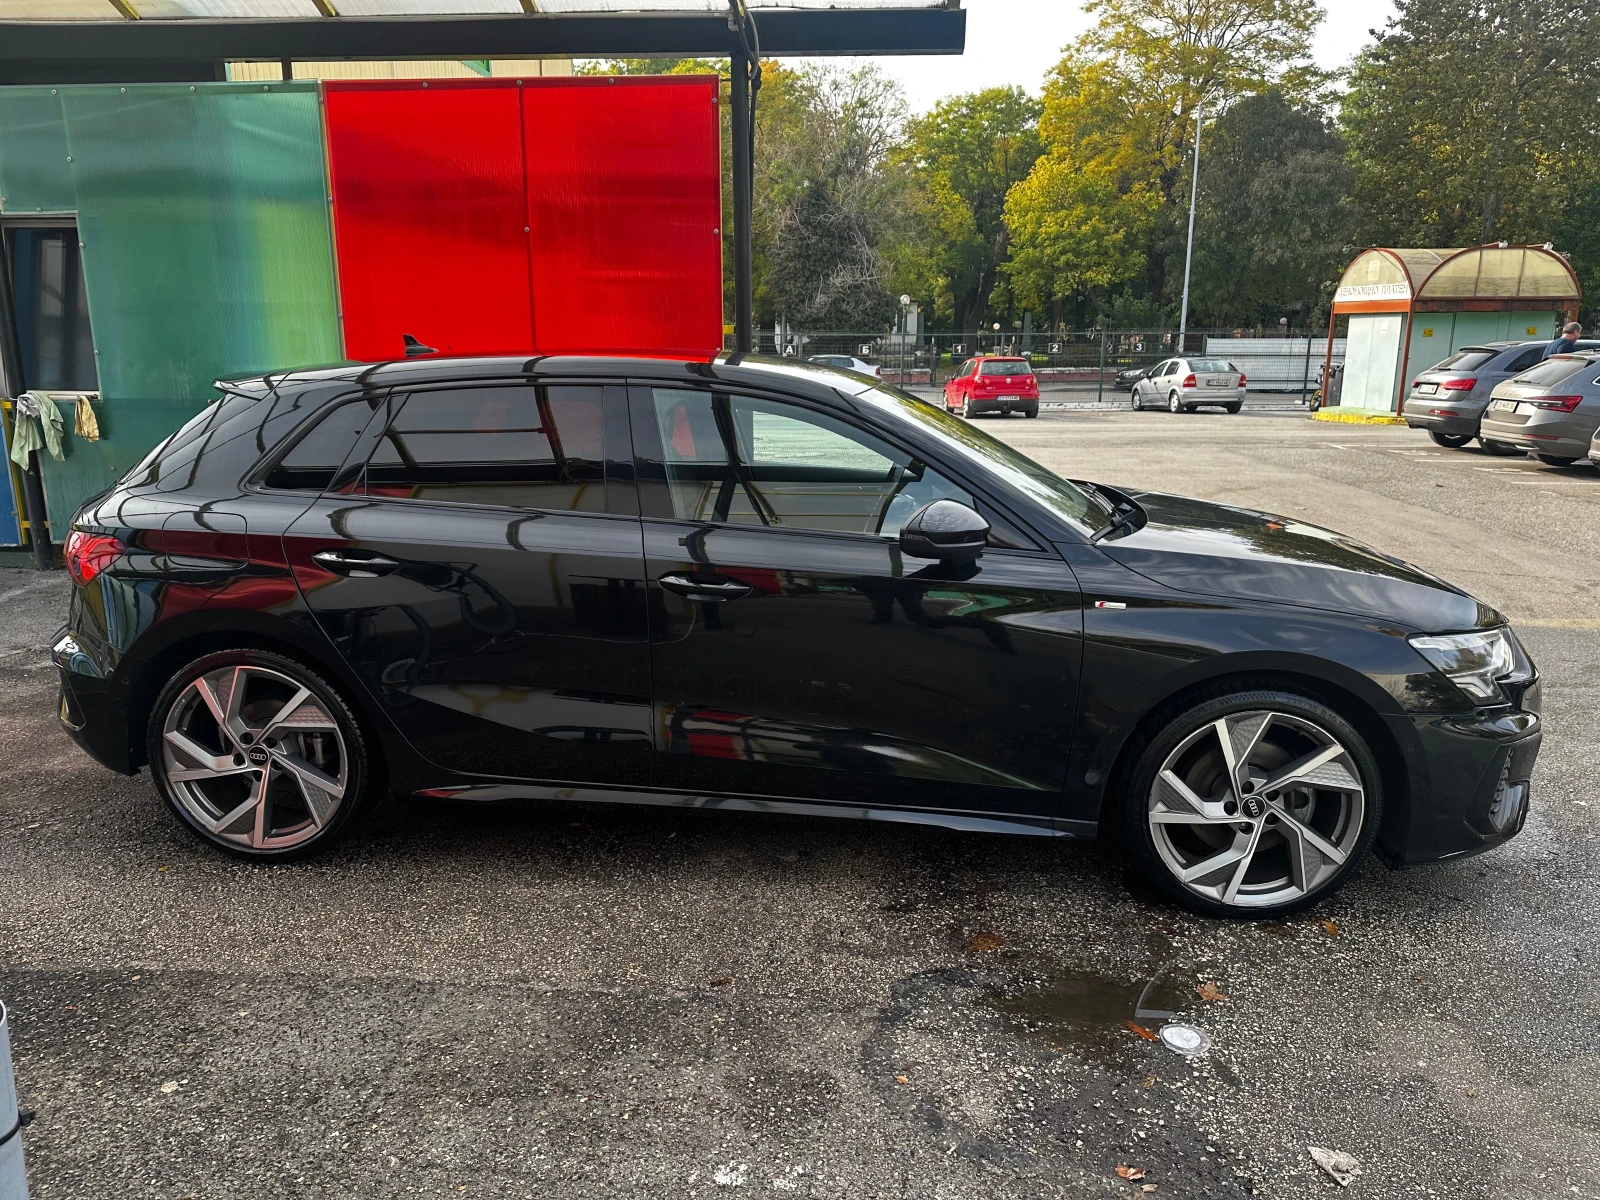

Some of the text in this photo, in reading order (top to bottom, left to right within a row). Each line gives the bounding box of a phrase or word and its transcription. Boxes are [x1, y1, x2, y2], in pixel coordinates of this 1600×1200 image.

[786, 345, 793, 353] А
[862, 345, 869, 353] Б
[1052, 344, 1059, 352] 2
[1135, 343, 1143, 351] 3
